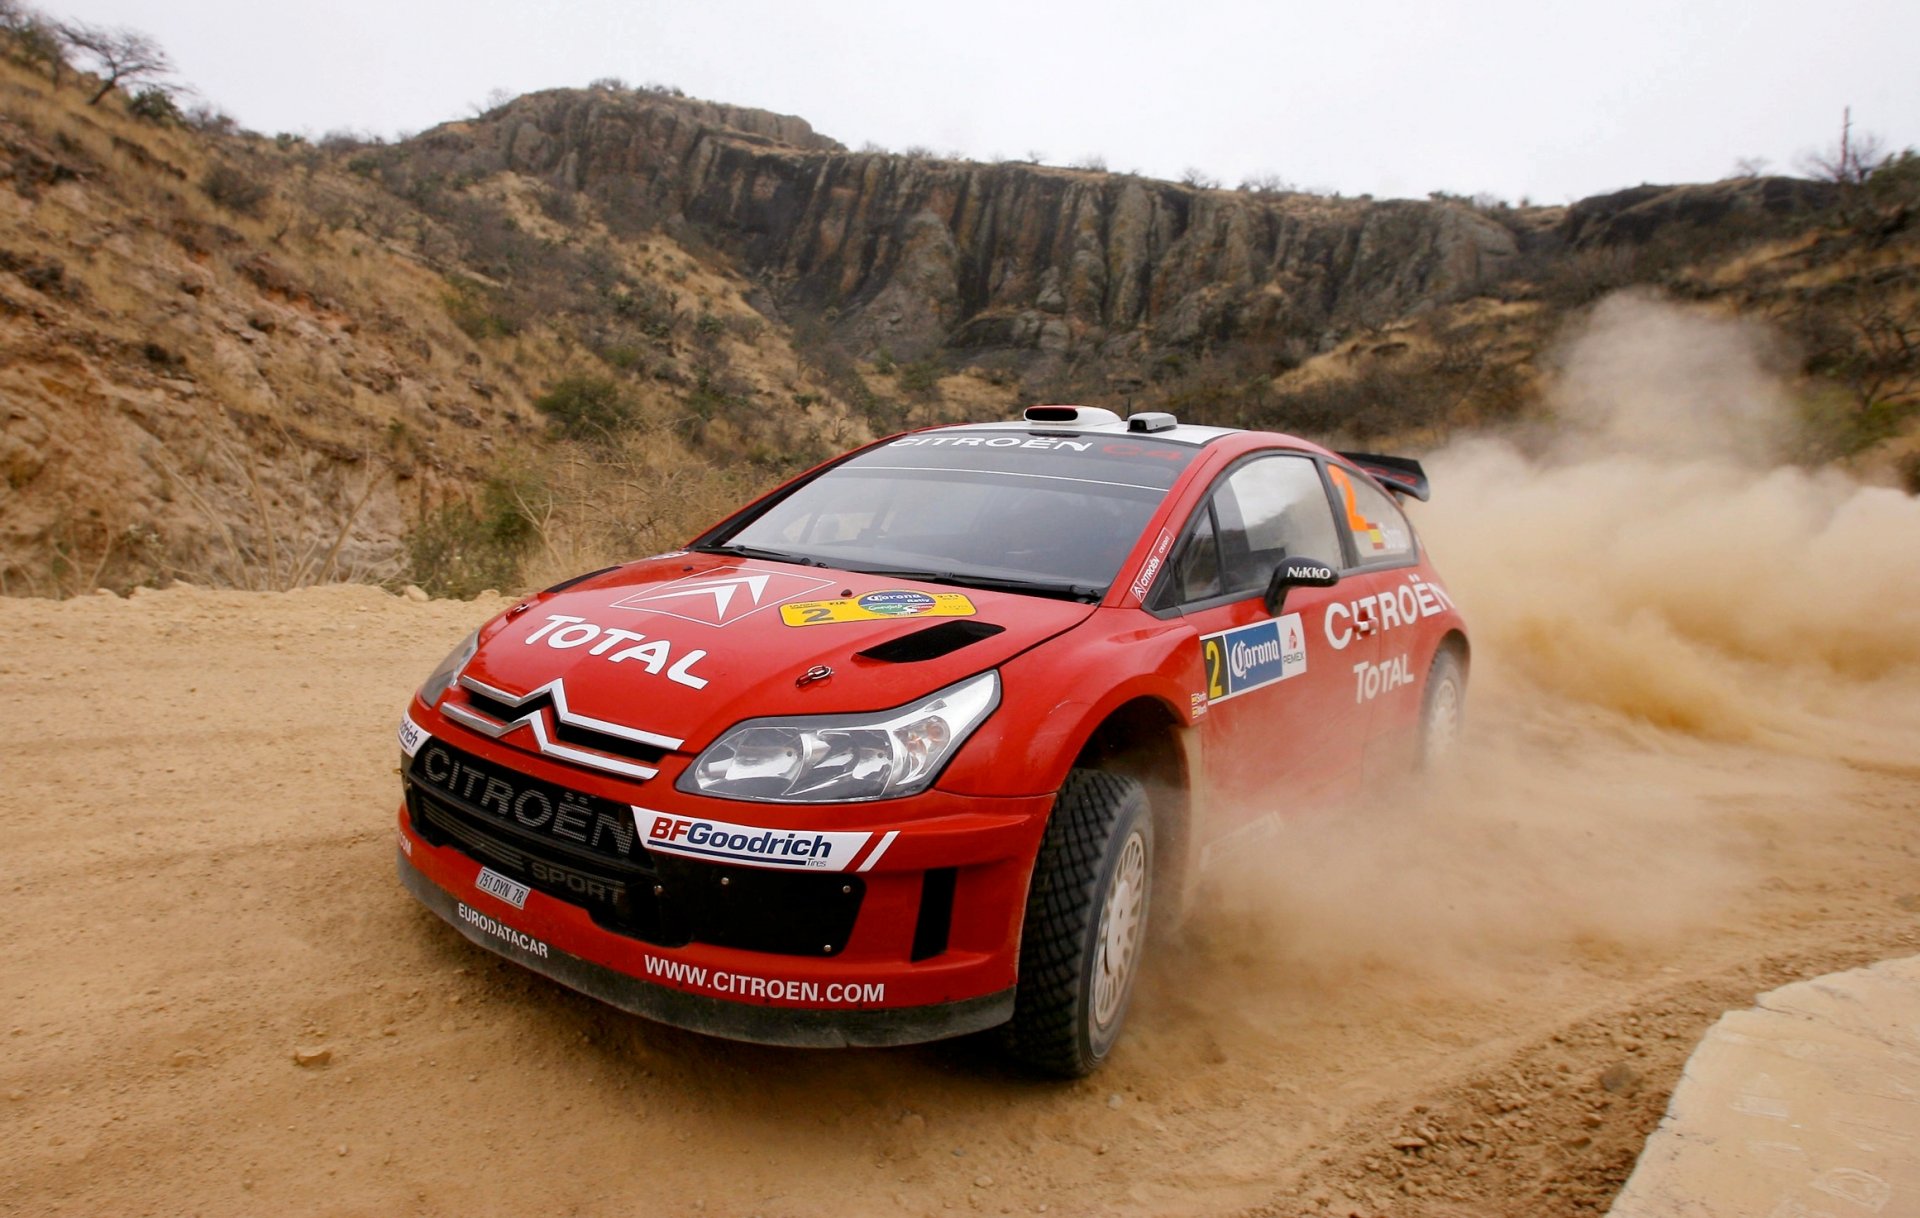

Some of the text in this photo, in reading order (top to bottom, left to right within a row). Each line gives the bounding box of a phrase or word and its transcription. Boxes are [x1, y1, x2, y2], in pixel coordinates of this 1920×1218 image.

[888, 436, 1094, 452] CITROËN
[1140, 555, 1160, 587] CITROËN
[801, 608, 835, 623] 2
[1206, 641, 1223, 699] 2
[1231, 639, 1281, 680] Corona
[1283, 651, 1305, 664] PEMEX
[424, 745, 635, 855] CITROËN
[649, 816, 833, 858] BFGoodrich
[479, 872, 493, 889] 751
[512, 888, 524, 903] 78
[531, 860, 627, 904] SPORT
[458, 902, 548, 958] EURODATACAR
[644, 954, 885, 1003] WWW.CITROEN.COM
